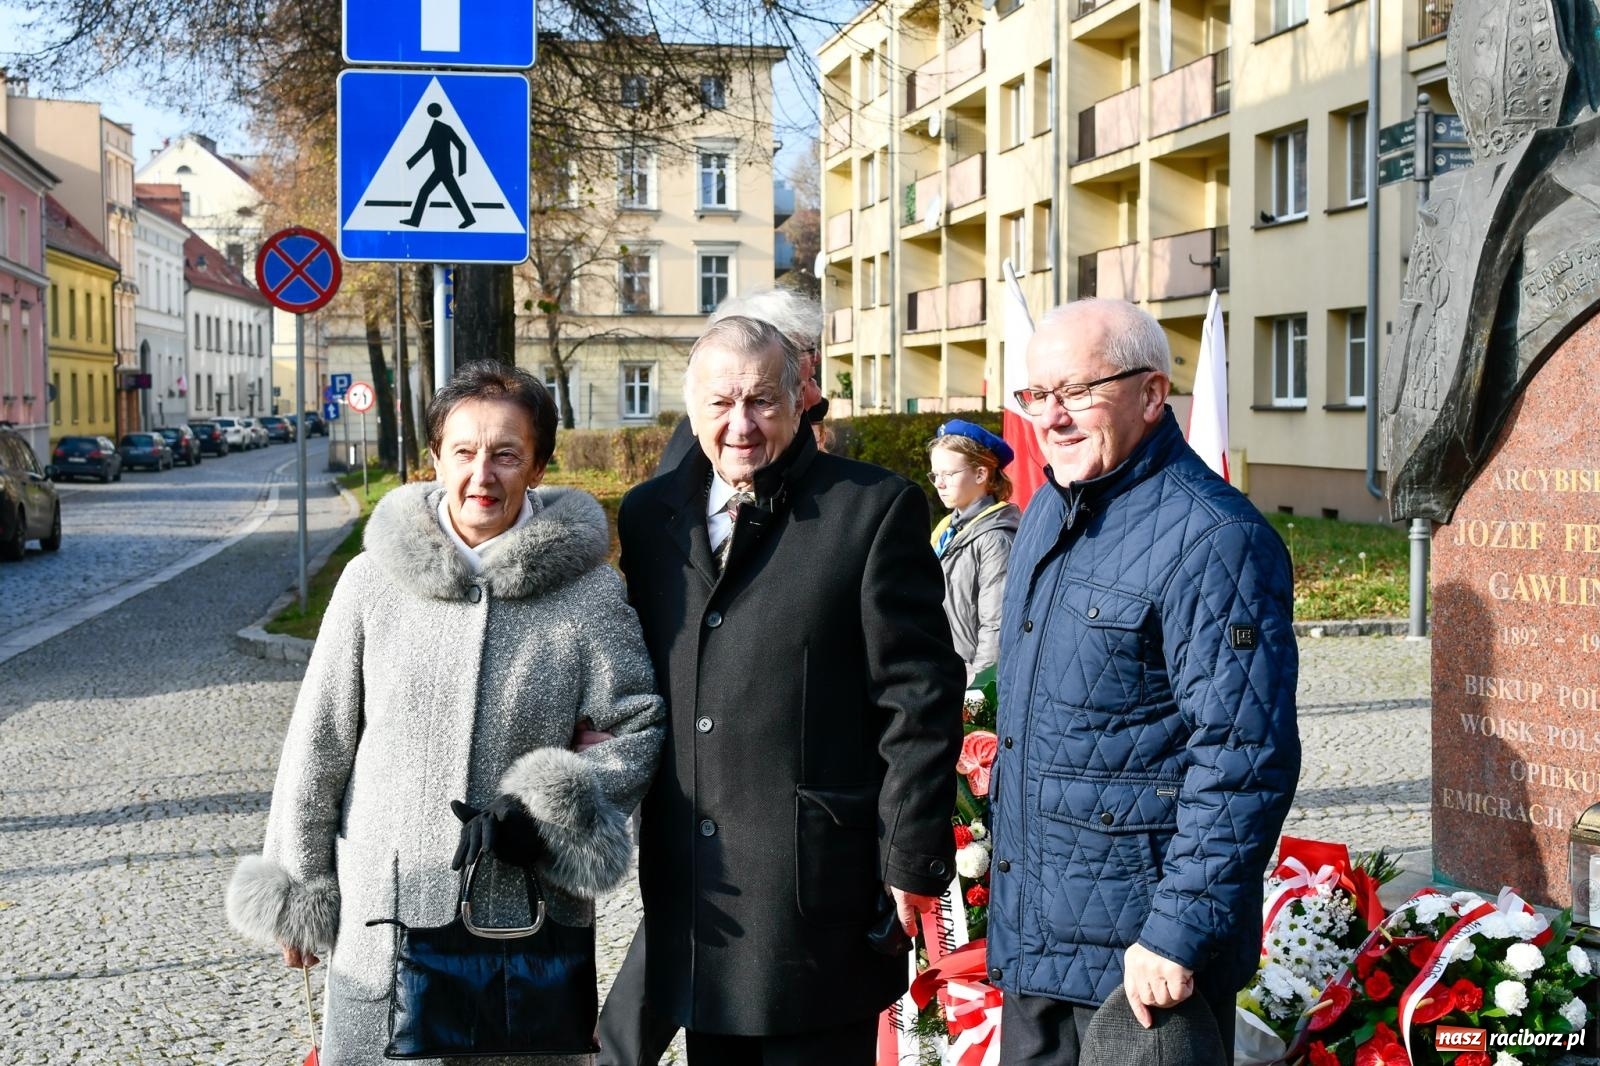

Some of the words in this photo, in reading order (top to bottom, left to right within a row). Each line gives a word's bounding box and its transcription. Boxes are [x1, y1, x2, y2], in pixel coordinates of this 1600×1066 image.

[335, 376, 348, 393] P
[1503, 626, 1539, 646] 1892
[1464, 674, 1544, 704] BISKUP
[1460, 712, 1535, 744] WOJSK
[1441, 788, 1564, 830] EMIGRACJI
